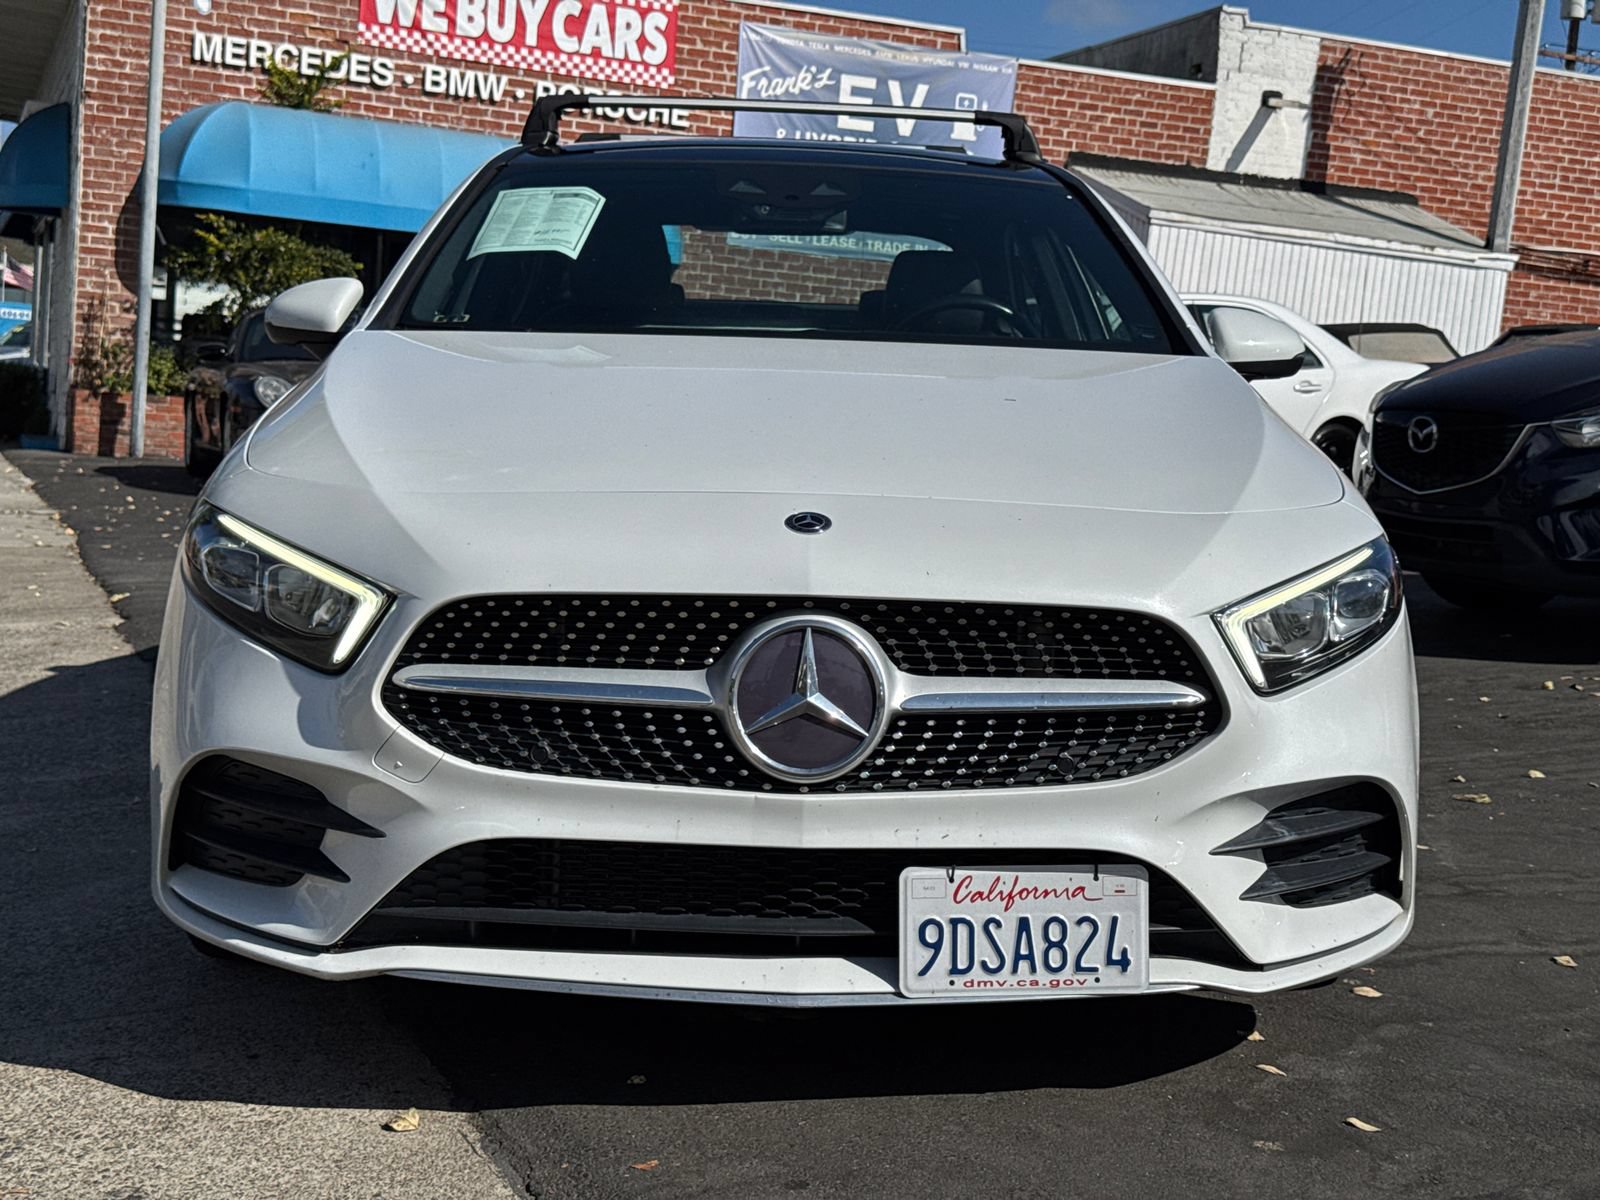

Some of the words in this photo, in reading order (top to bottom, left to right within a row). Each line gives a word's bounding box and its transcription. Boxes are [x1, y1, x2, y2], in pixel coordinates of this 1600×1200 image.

[374, 0, 449, 34] WE
[455, 0, 548, 47] BUY
[552, 0, 669, 65] CARS
[192, 31, 395, 87] MERCEDES
[424, 64, 508, 102] BMW
[740, 64, 837, 98] Frank's
[836, 73, 930, 137] EV
[813, 235, 857, 248] LEASE
[953, 875, 1103, 912] California
[917, 914, 1132, 977] 9DSA824
[963, 977, 1088, 989] dmv.ca.gov
